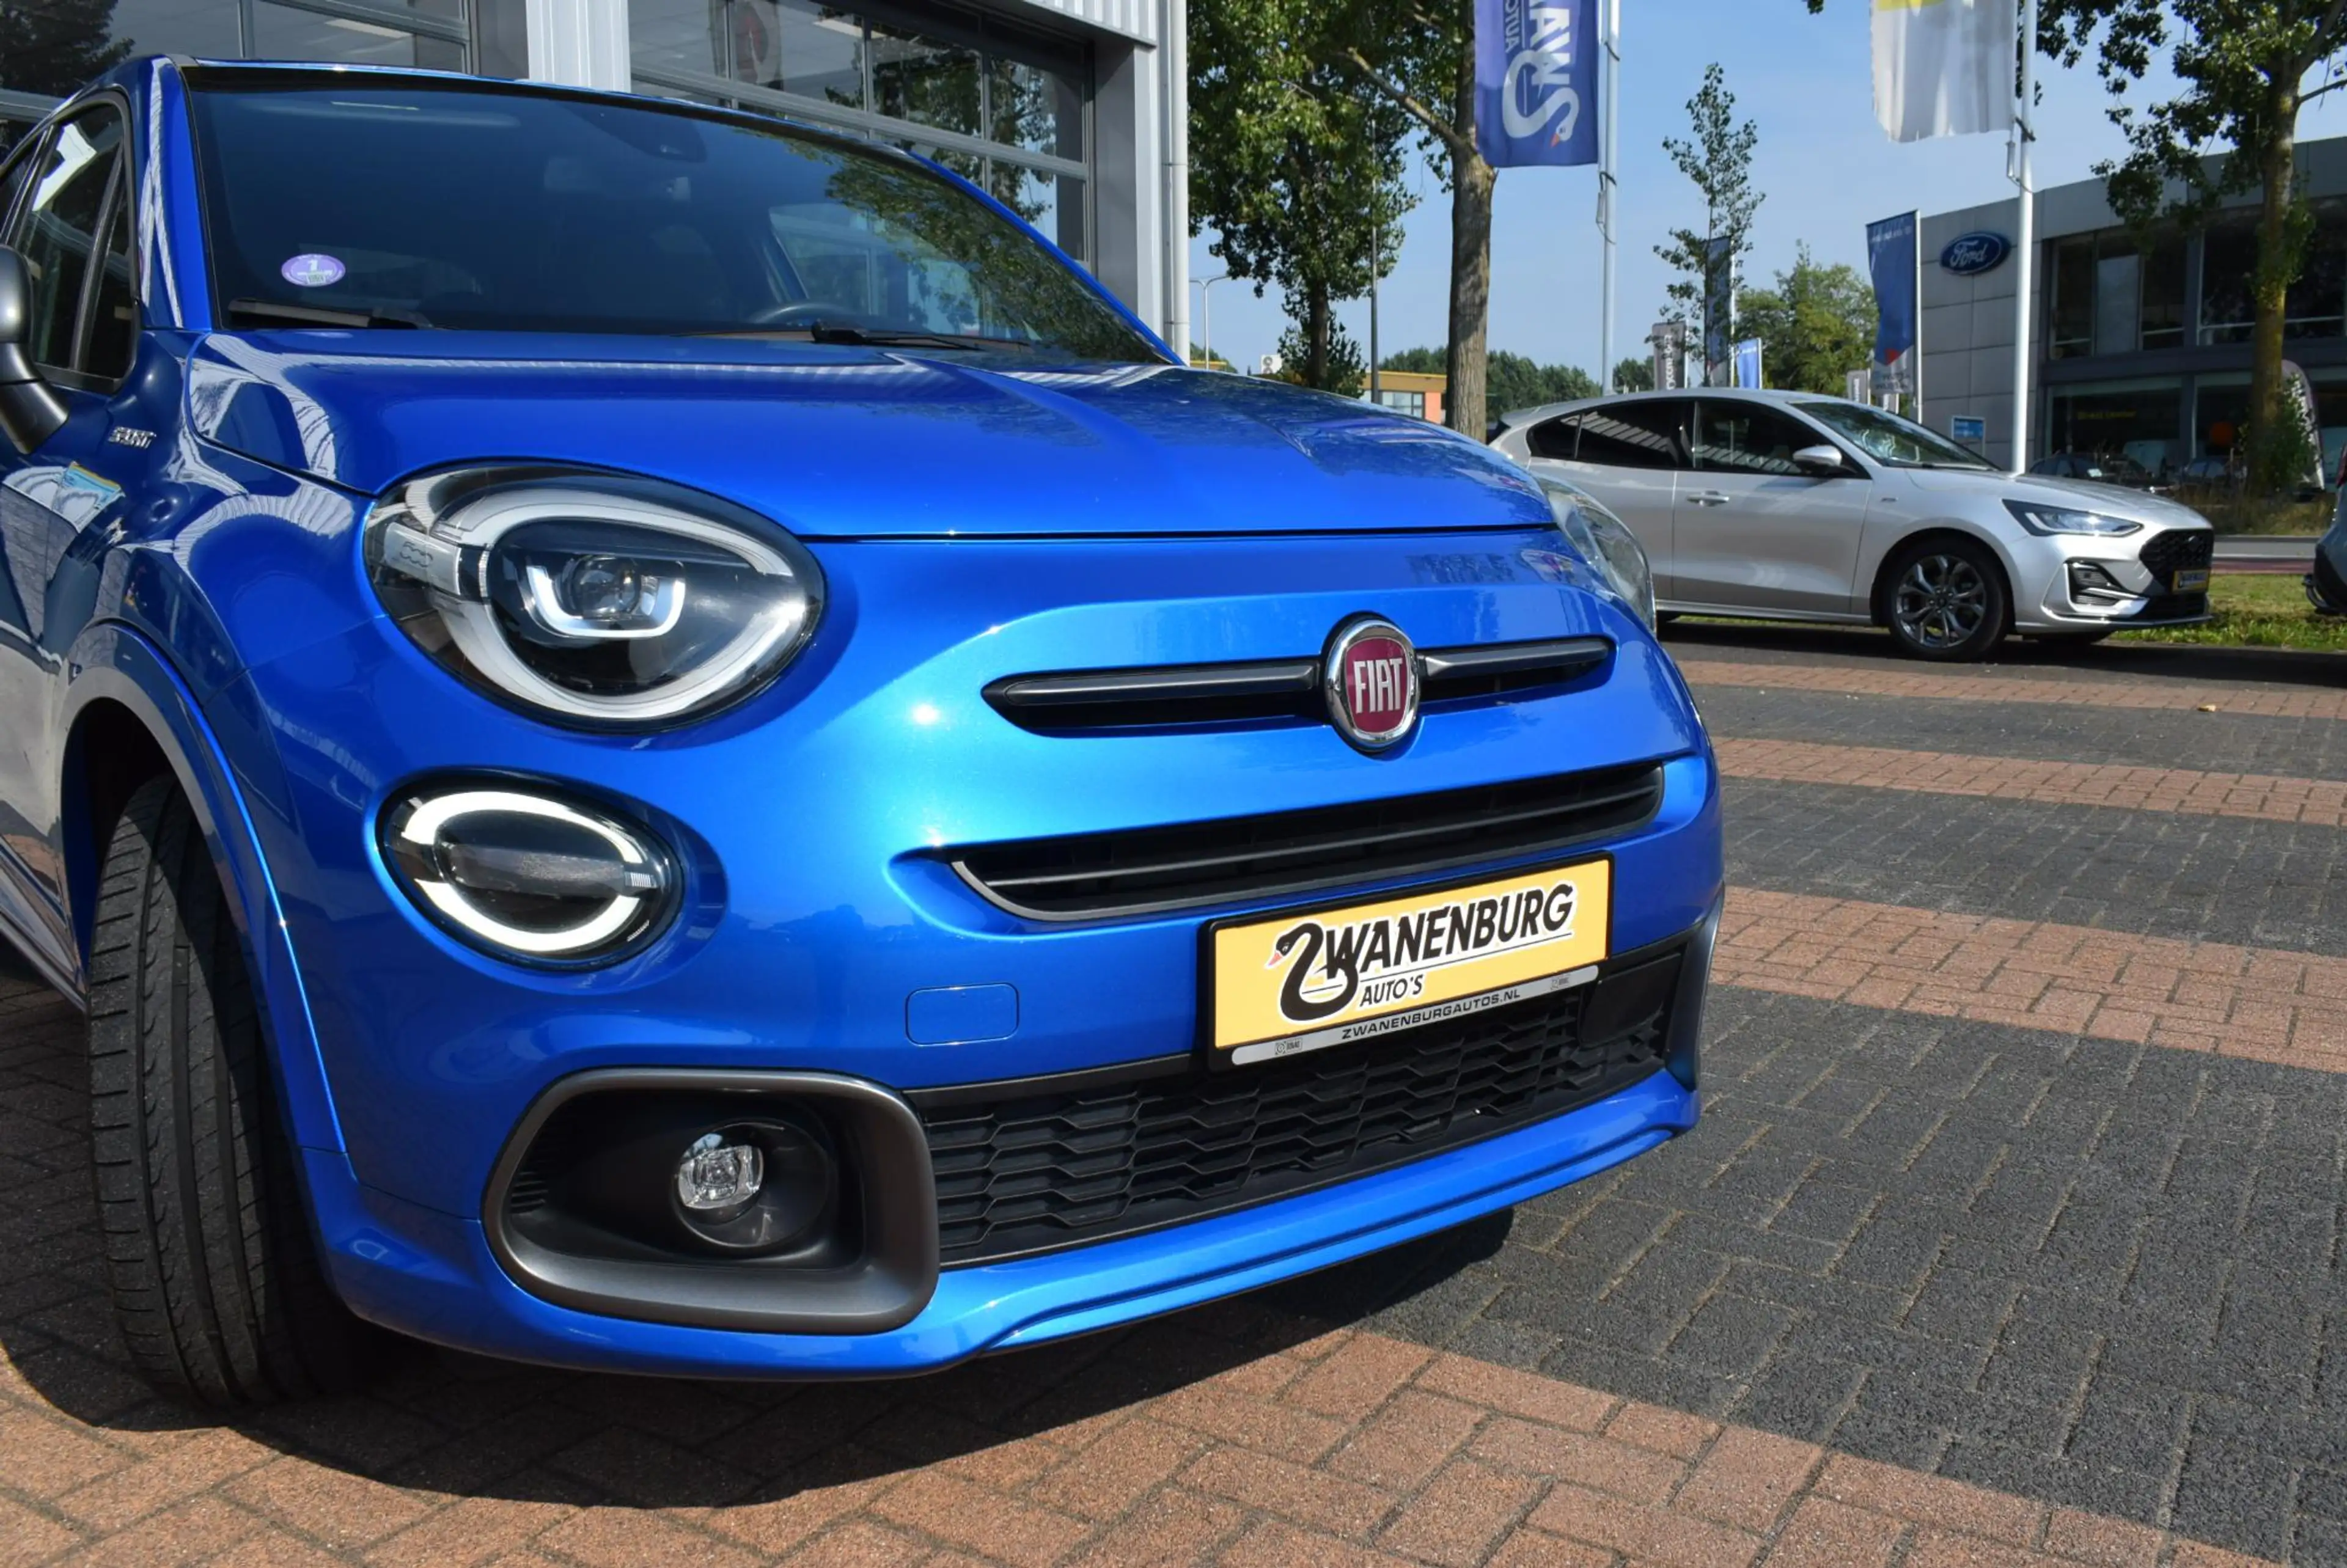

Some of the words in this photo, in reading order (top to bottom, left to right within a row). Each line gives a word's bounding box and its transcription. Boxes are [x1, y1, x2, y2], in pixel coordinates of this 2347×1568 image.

[1950, 239, 1989, 267] Ford
[1353, 658, 1403, 714] FIAT
[1268, 884, 1573, 1021] ZWANENBURG
[1341, 989, 1521, 1040] ZWANENBURGAUTOS.NL
[1359, 974, 1424, 1007] AUTO'S
